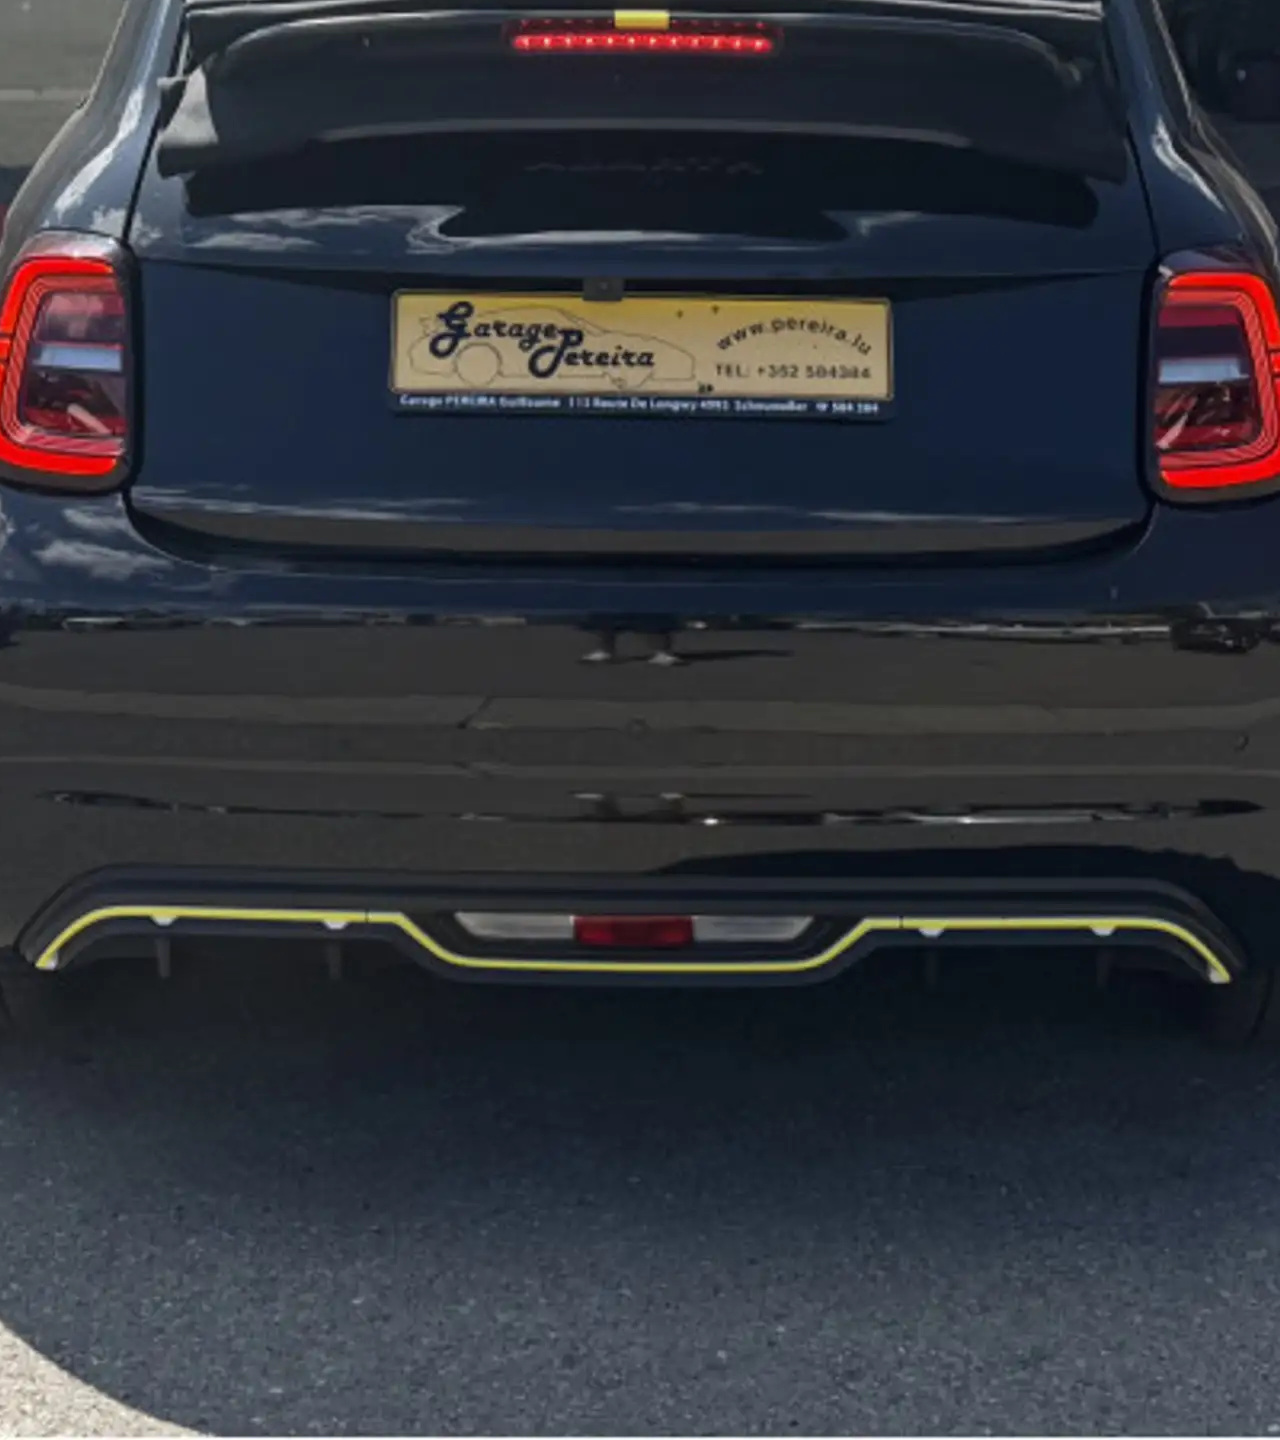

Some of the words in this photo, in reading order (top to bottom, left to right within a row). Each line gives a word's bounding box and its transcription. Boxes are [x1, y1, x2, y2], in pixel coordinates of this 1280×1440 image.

[429, 300, 558, 359] Garage
[528, 328, 656, 379] Pereira
[716, 316, 872, 356] www.pereira.lu
